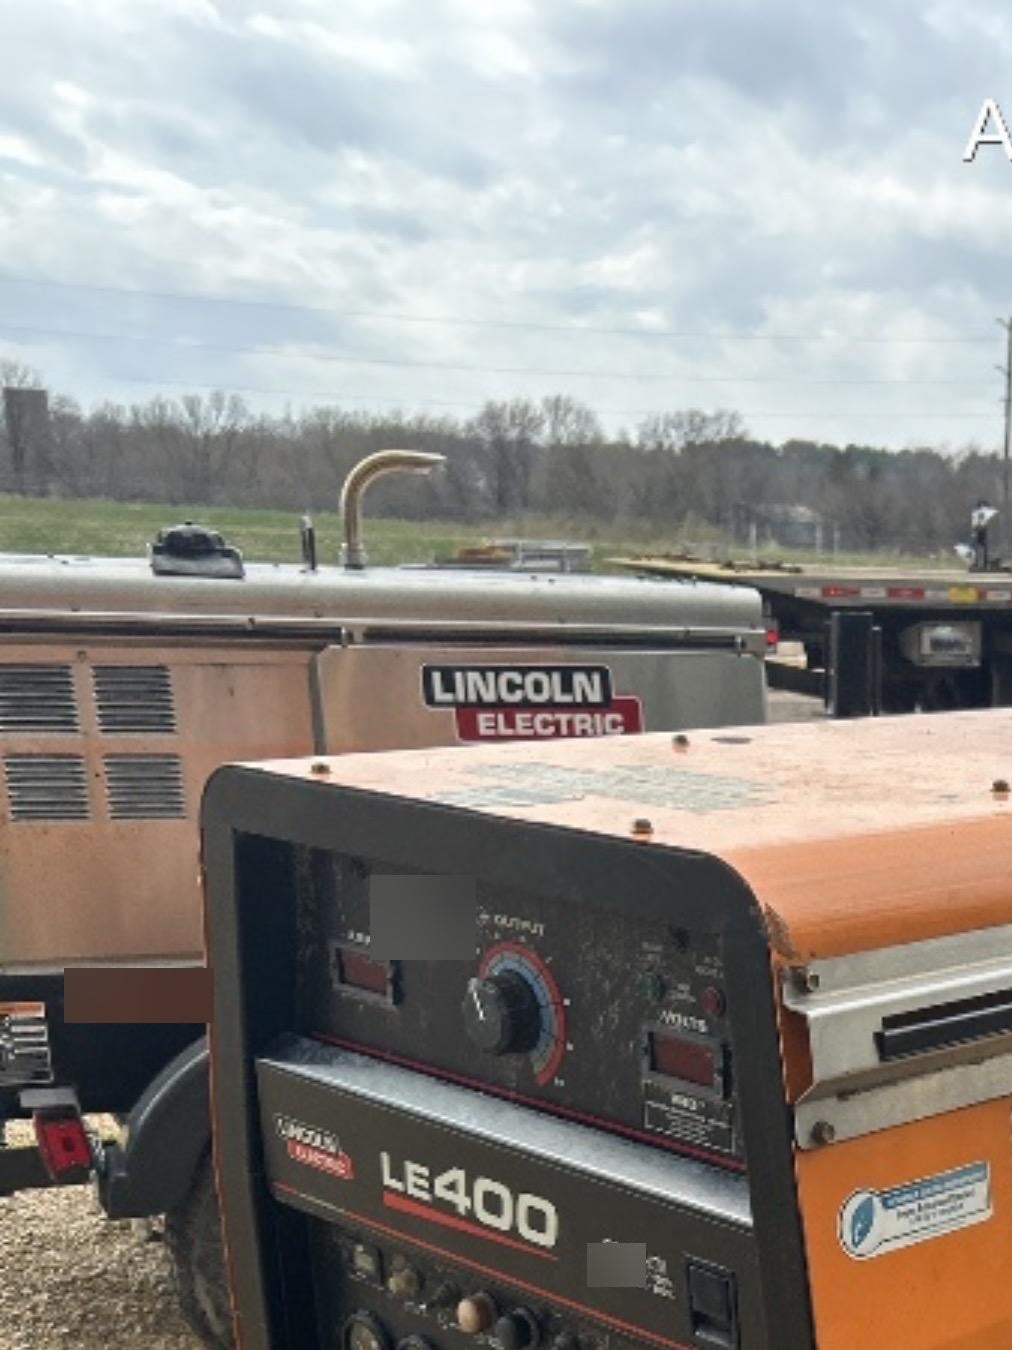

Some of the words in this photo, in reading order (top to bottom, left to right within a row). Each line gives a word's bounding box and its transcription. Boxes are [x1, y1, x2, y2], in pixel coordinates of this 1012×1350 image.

[431, 671, 603, 704] LINCOLN
[477, 713, 625, 737] ELECTRIC
[379, 1151, 560, 1248] LE400
